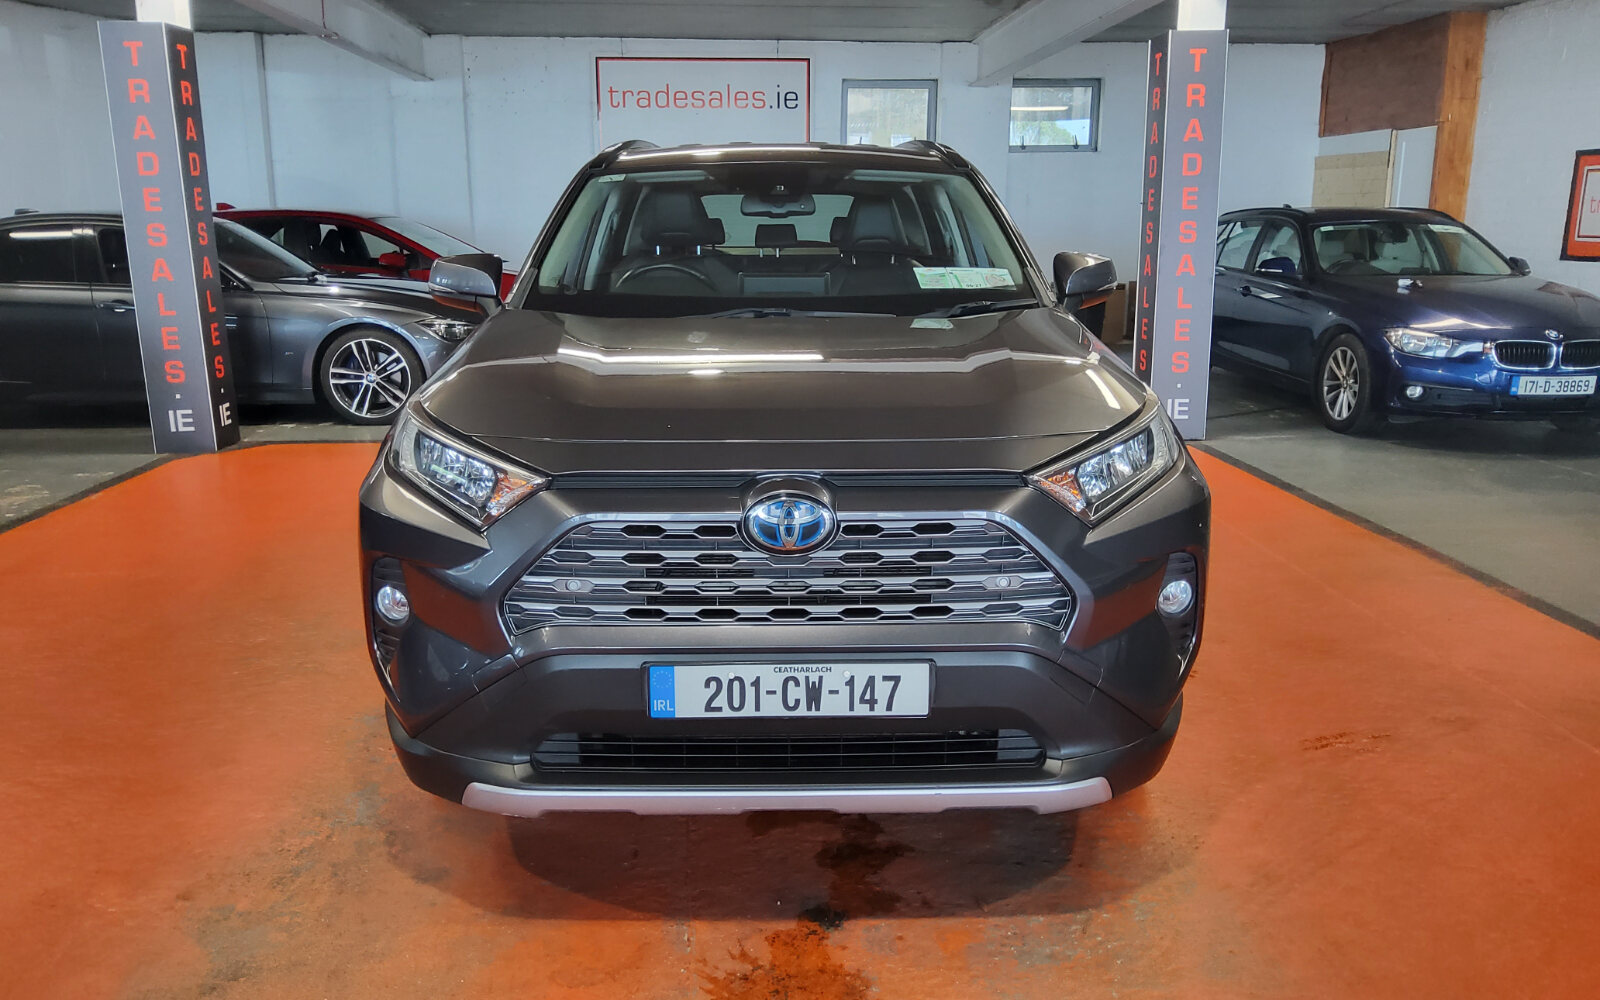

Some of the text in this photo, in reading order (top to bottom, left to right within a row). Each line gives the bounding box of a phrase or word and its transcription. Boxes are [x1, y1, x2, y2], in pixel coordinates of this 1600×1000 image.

[608, 83, 799, 109] tradesales.ie
[1524, 380, 1590, 393] 171-D-38869
[703, 675, 902, 713] 201-CW-147
[653, 699, 674, 711] IRL
